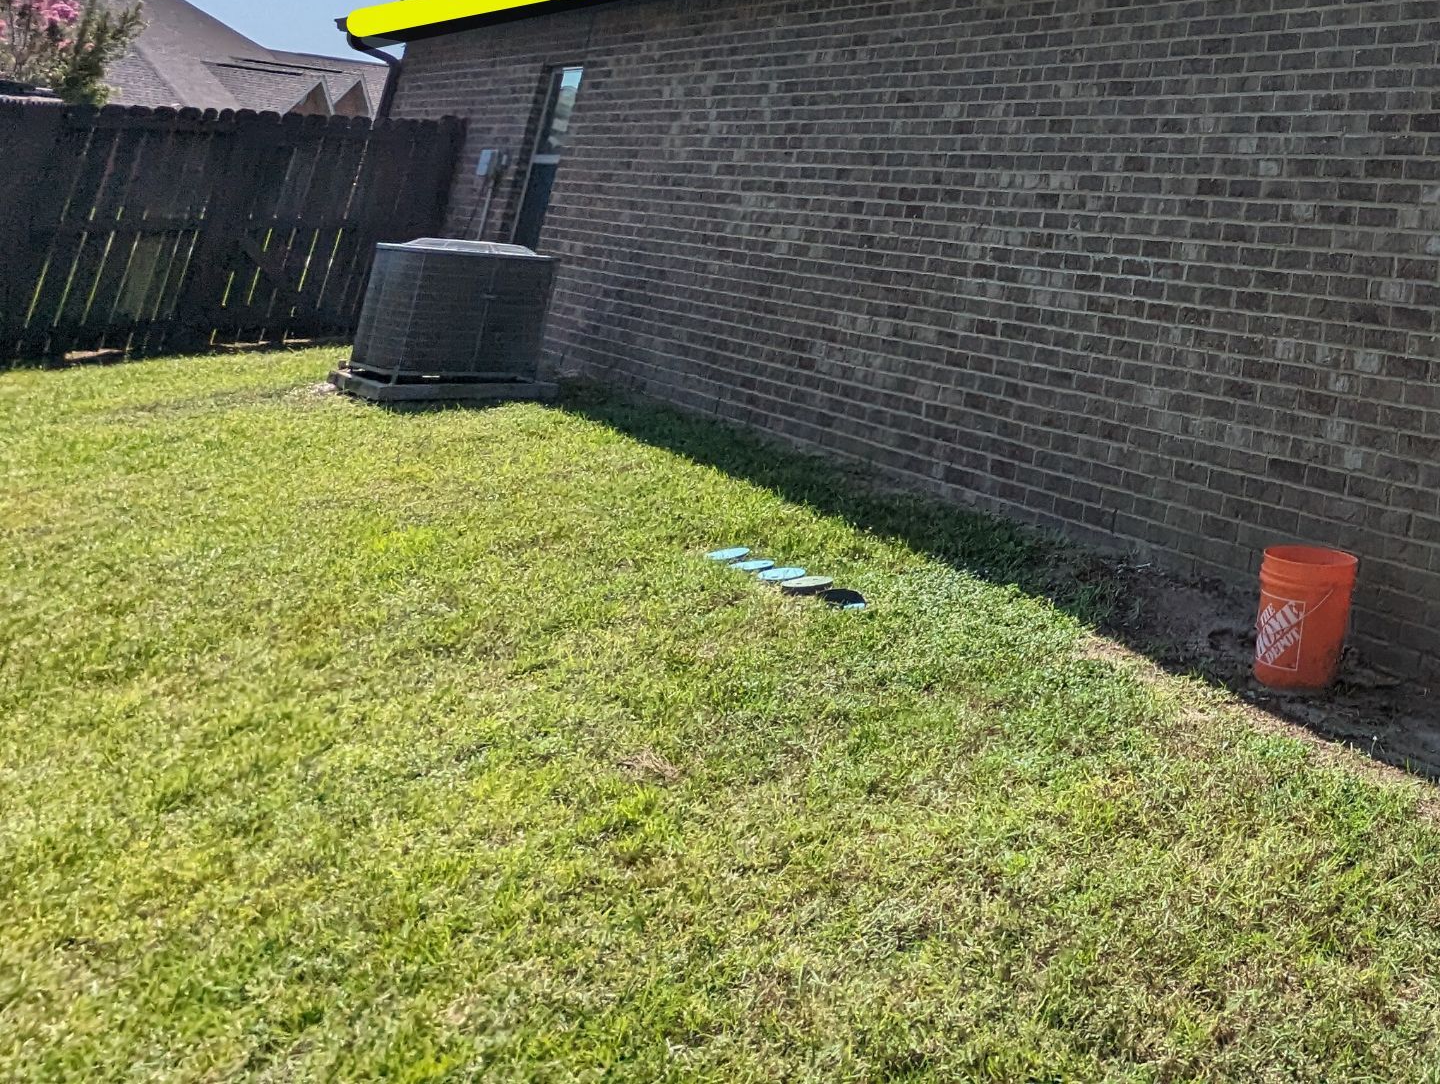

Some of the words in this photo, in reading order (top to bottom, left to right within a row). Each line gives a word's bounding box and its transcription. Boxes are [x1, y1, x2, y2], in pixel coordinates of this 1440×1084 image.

[1256, 601, 1303, 659] HOME
[1260, 603, 1275, 627] THE
[1265, 627, 1300, 664] DEPOT
